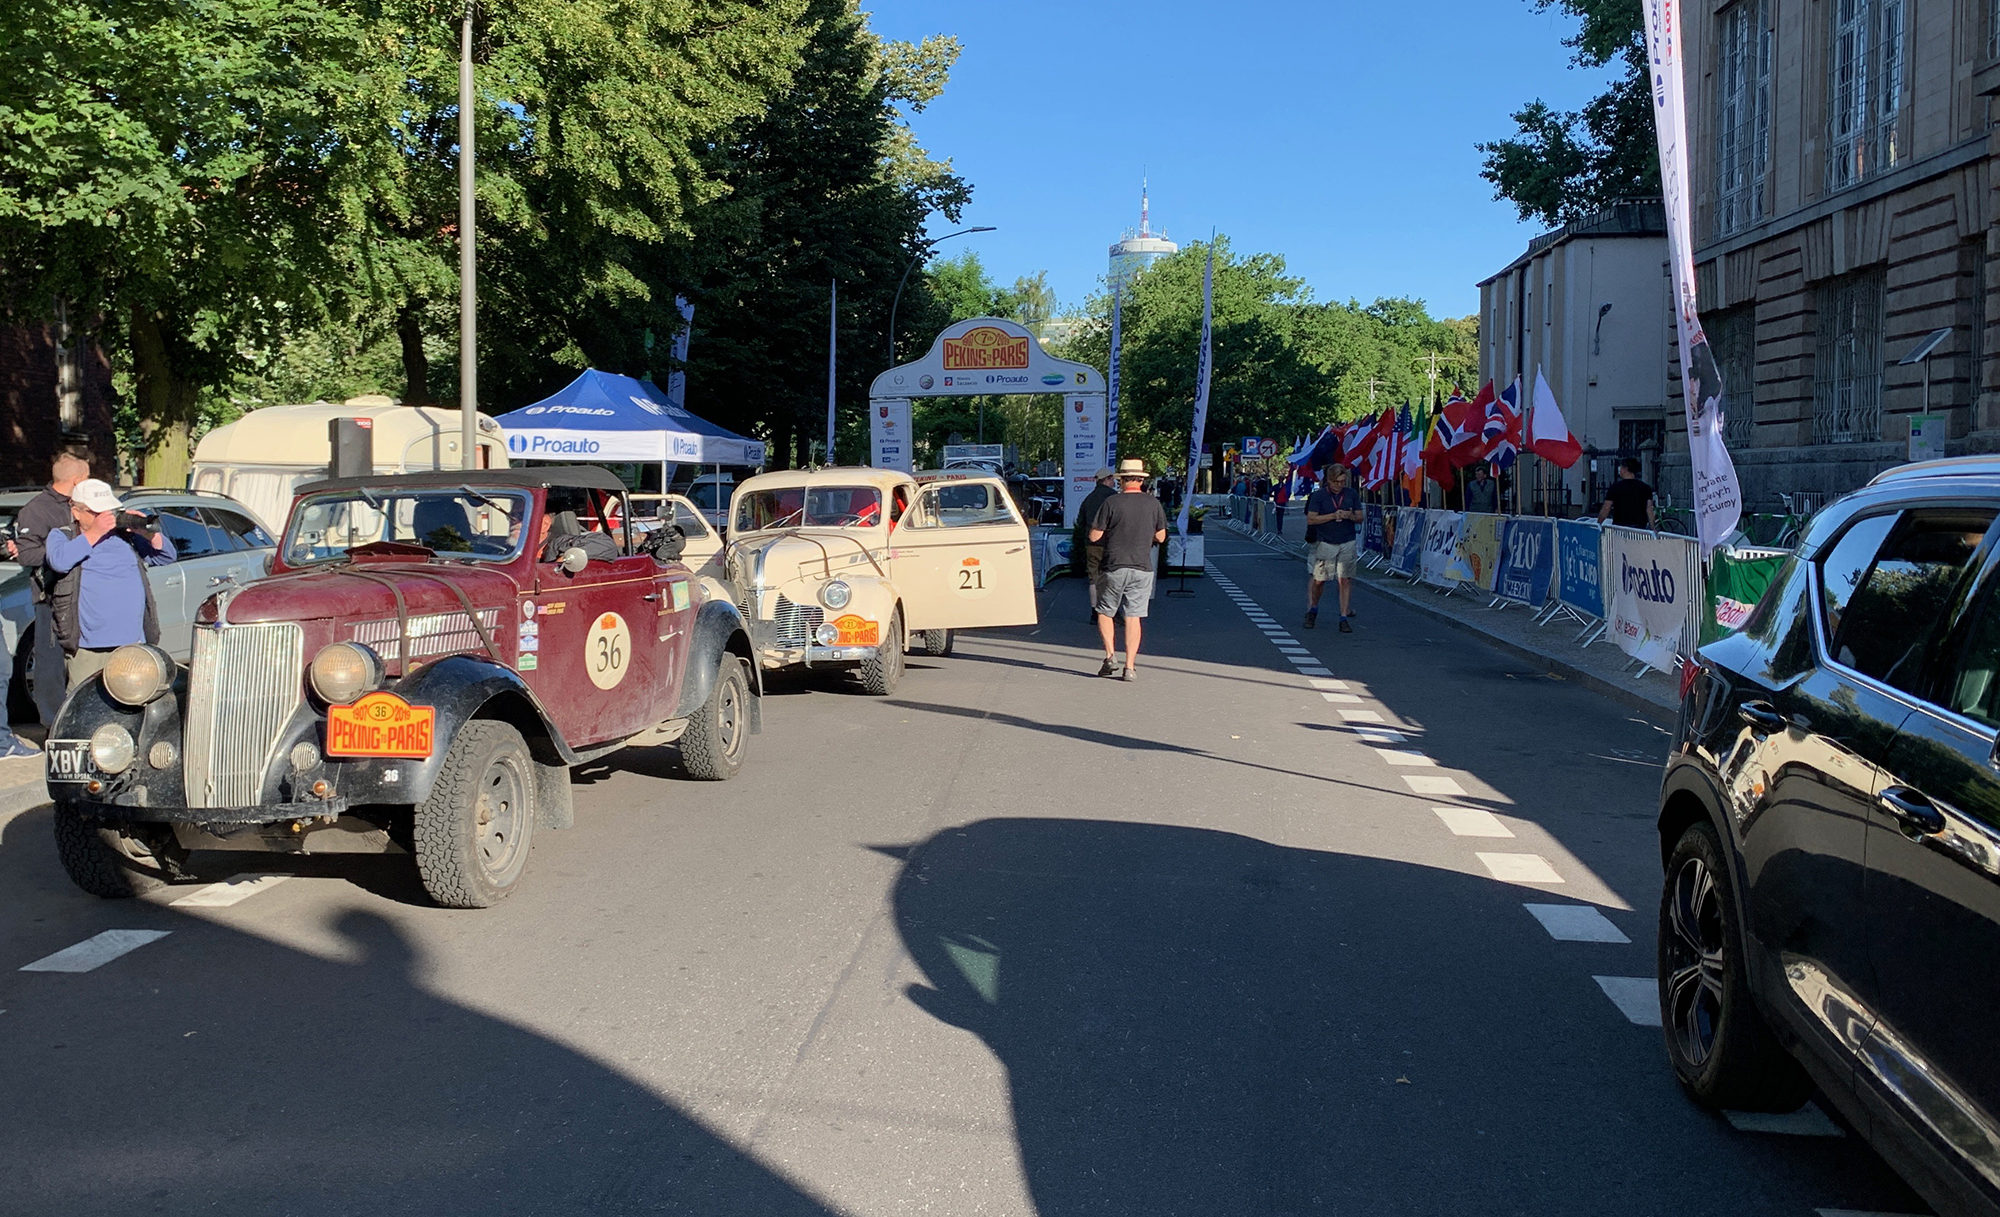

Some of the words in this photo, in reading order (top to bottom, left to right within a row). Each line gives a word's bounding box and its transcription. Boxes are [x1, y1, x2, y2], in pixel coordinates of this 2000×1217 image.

[946, 342, 987, 366] PEKING
[992, 341, 1026, 366] PARIS
[996, 375, 1029, 383] Proauto
[546, 405, 616, 416] Proauto
[531, 435, 600, 453] Proauto
[680, 439, 698, 456] Proauto
[958, 568, 986, 590] 21
[854, 627, 877, 643] PARIS
[596, 634, 622, 673] 36
[352, 704, 368, 721] 1907
[375, 706, 387, 717] 36
[394, 705, 411, 722] 2019
[333, 716, 380, 750] PEKING
[387, 718, 430, 751] PARIS
[49, 749, 83, 773] XBV
[384, 769, 399, 782] 36
